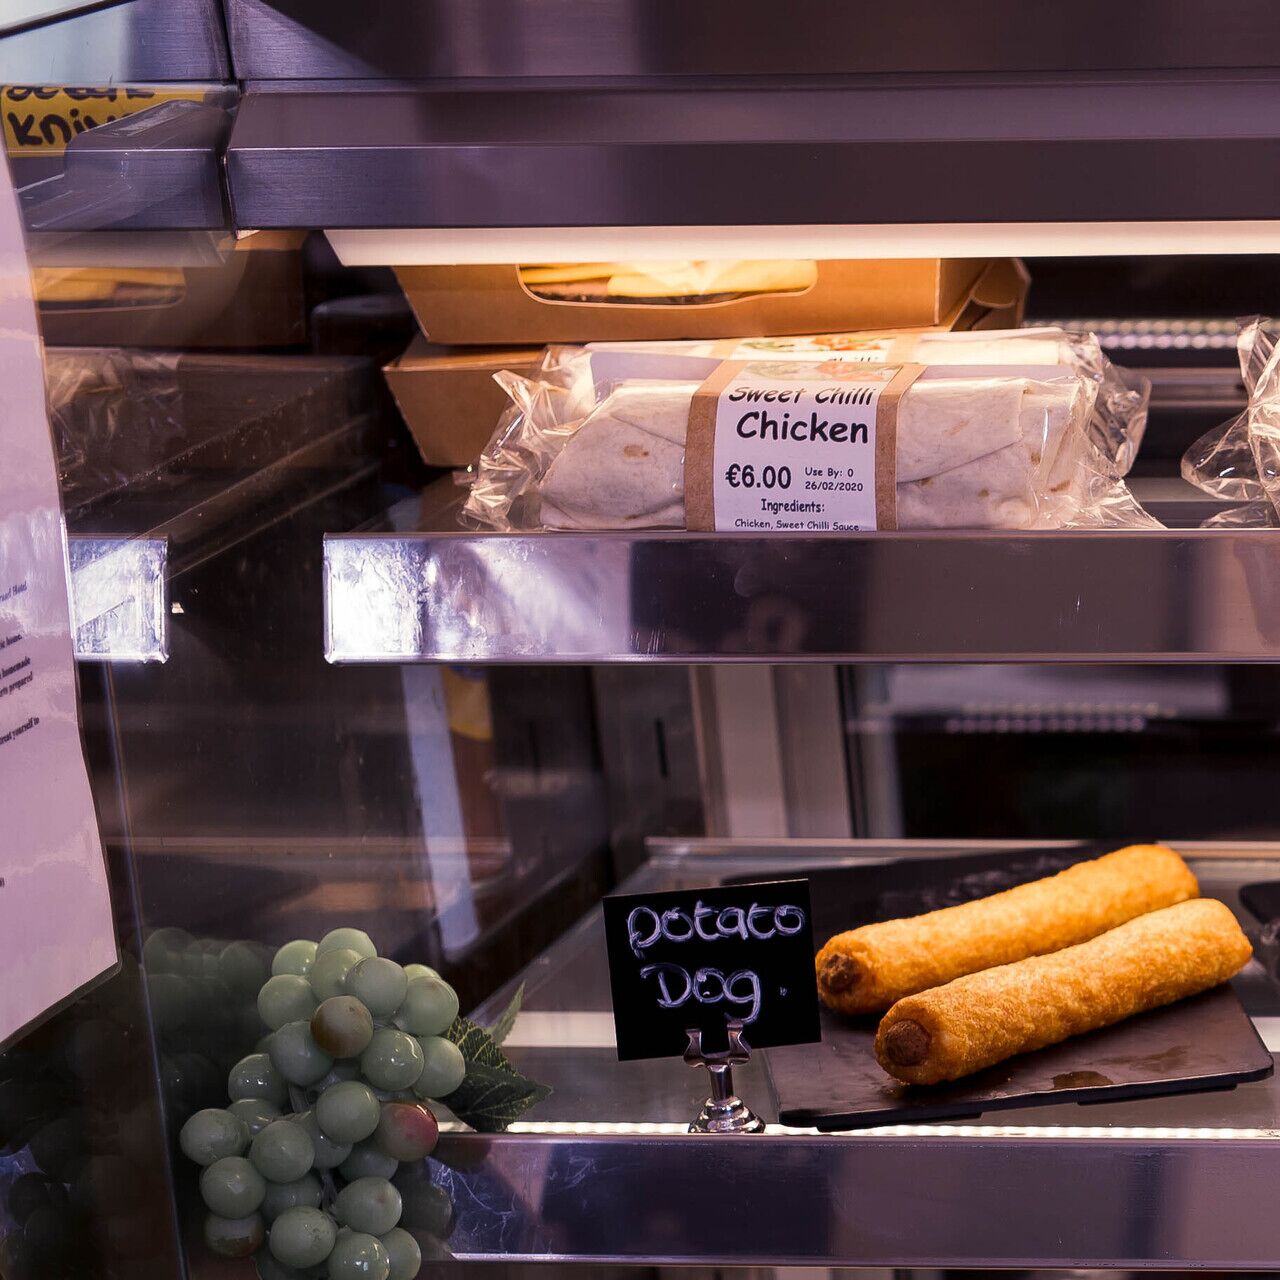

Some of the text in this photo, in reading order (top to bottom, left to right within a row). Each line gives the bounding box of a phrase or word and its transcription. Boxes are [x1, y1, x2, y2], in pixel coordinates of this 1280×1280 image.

[728, 386, 877, 405] Sweet Chilli
[736, 410, 869, 444] Chicken
[725, 463, 792, 490] €6.00
[804, 481, 864, 492] 26/02/2020
[761, 499, 825, 514] Ingredients:
[640, 962, 761, 1024] Dog
